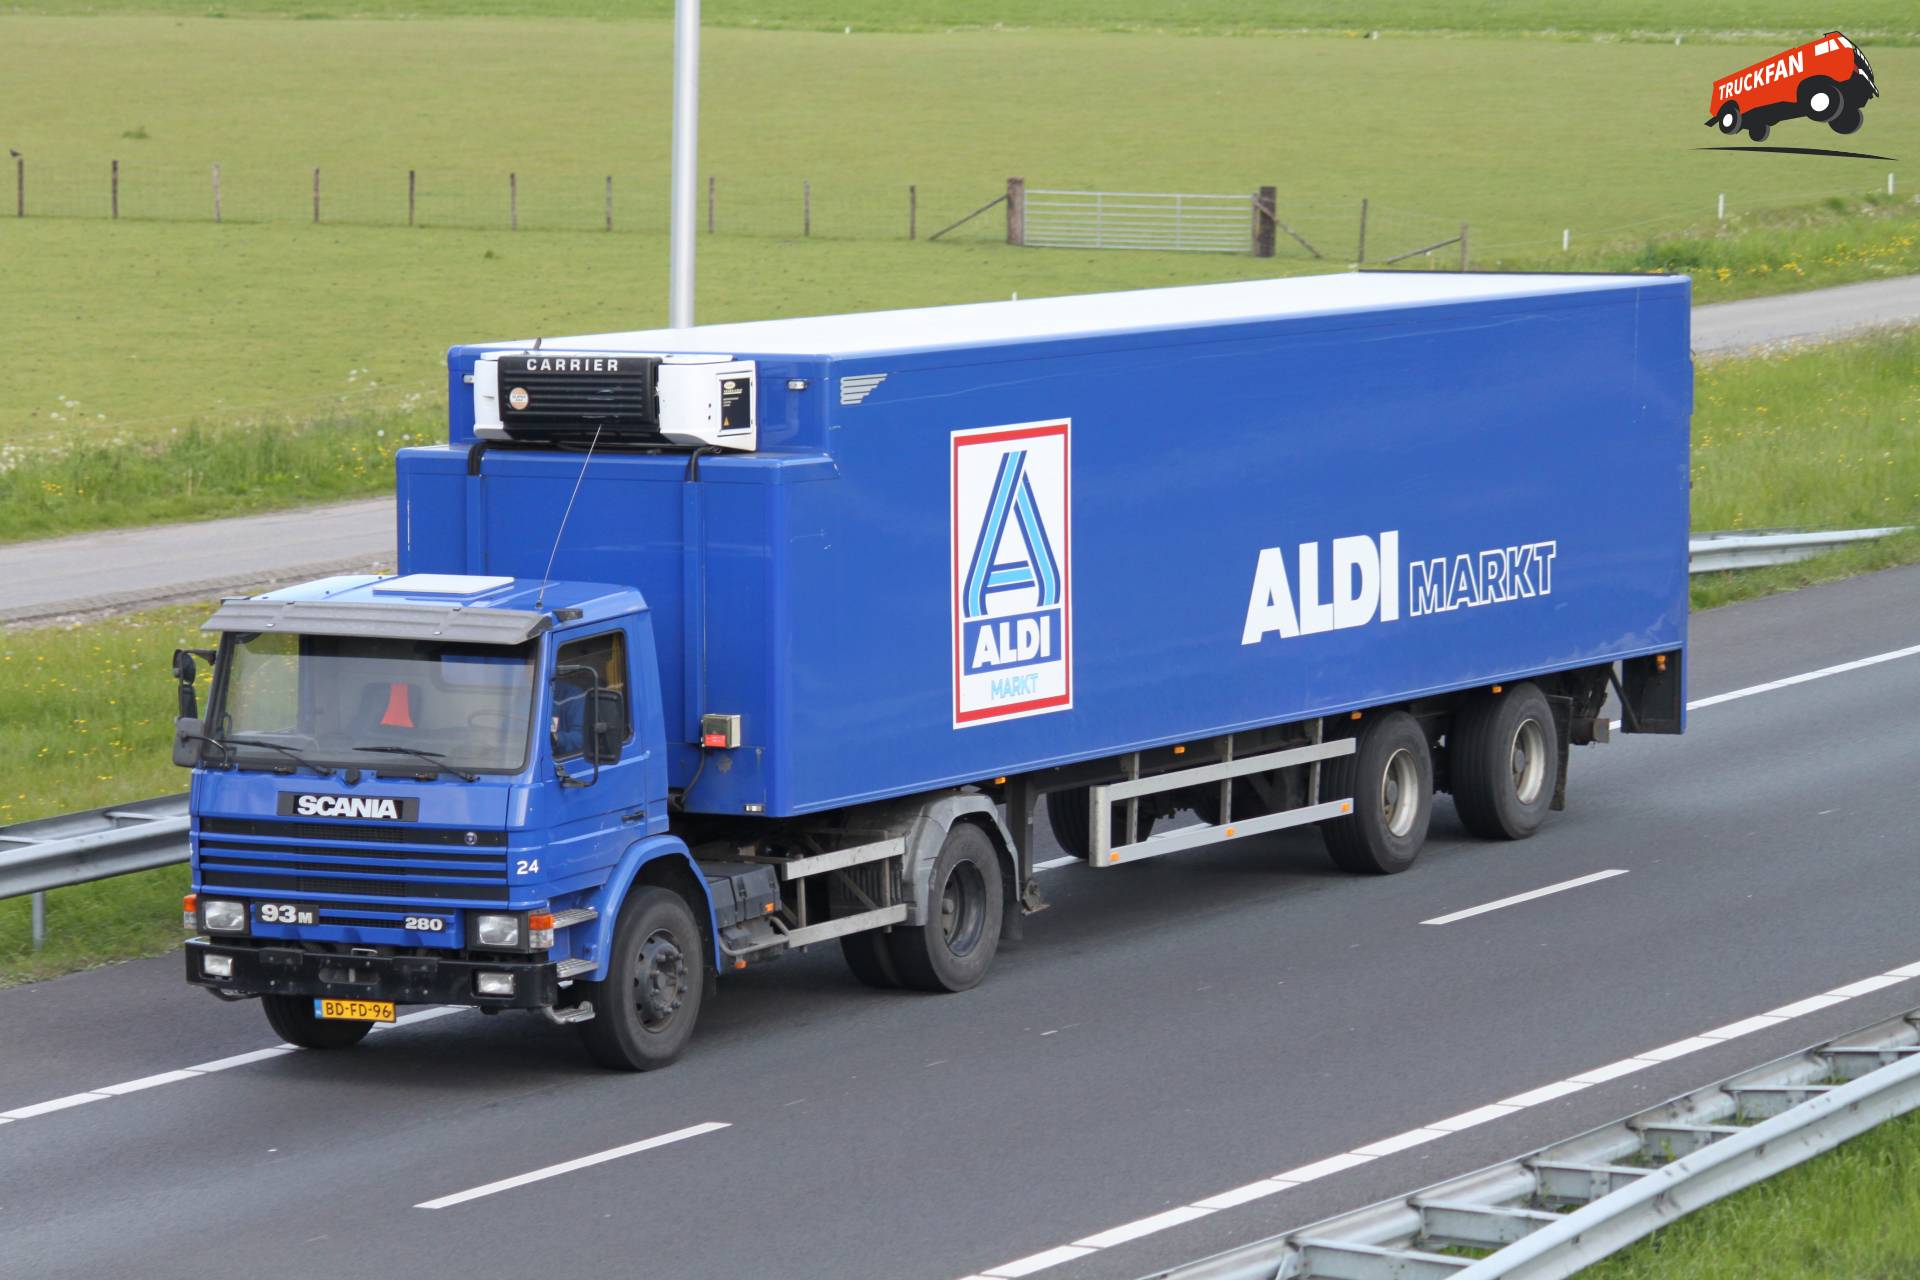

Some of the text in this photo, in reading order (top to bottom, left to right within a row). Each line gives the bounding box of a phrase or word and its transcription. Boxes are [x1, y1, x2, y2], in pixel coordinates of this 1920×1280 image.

[526, 358, 619, 372] CARRIER
[1241, 529, 1557, 646] ALDI MARKT
[971, 615, 1051, 670] ALDI
[991, 672, 1039, 701] MARKT
[296, 794, 399, 820] SCANIA
[516, 858, 540, 876] 24
[404, 916, 444, 932] 280
[324, 1001, 393, 1019] BD-FD-96
